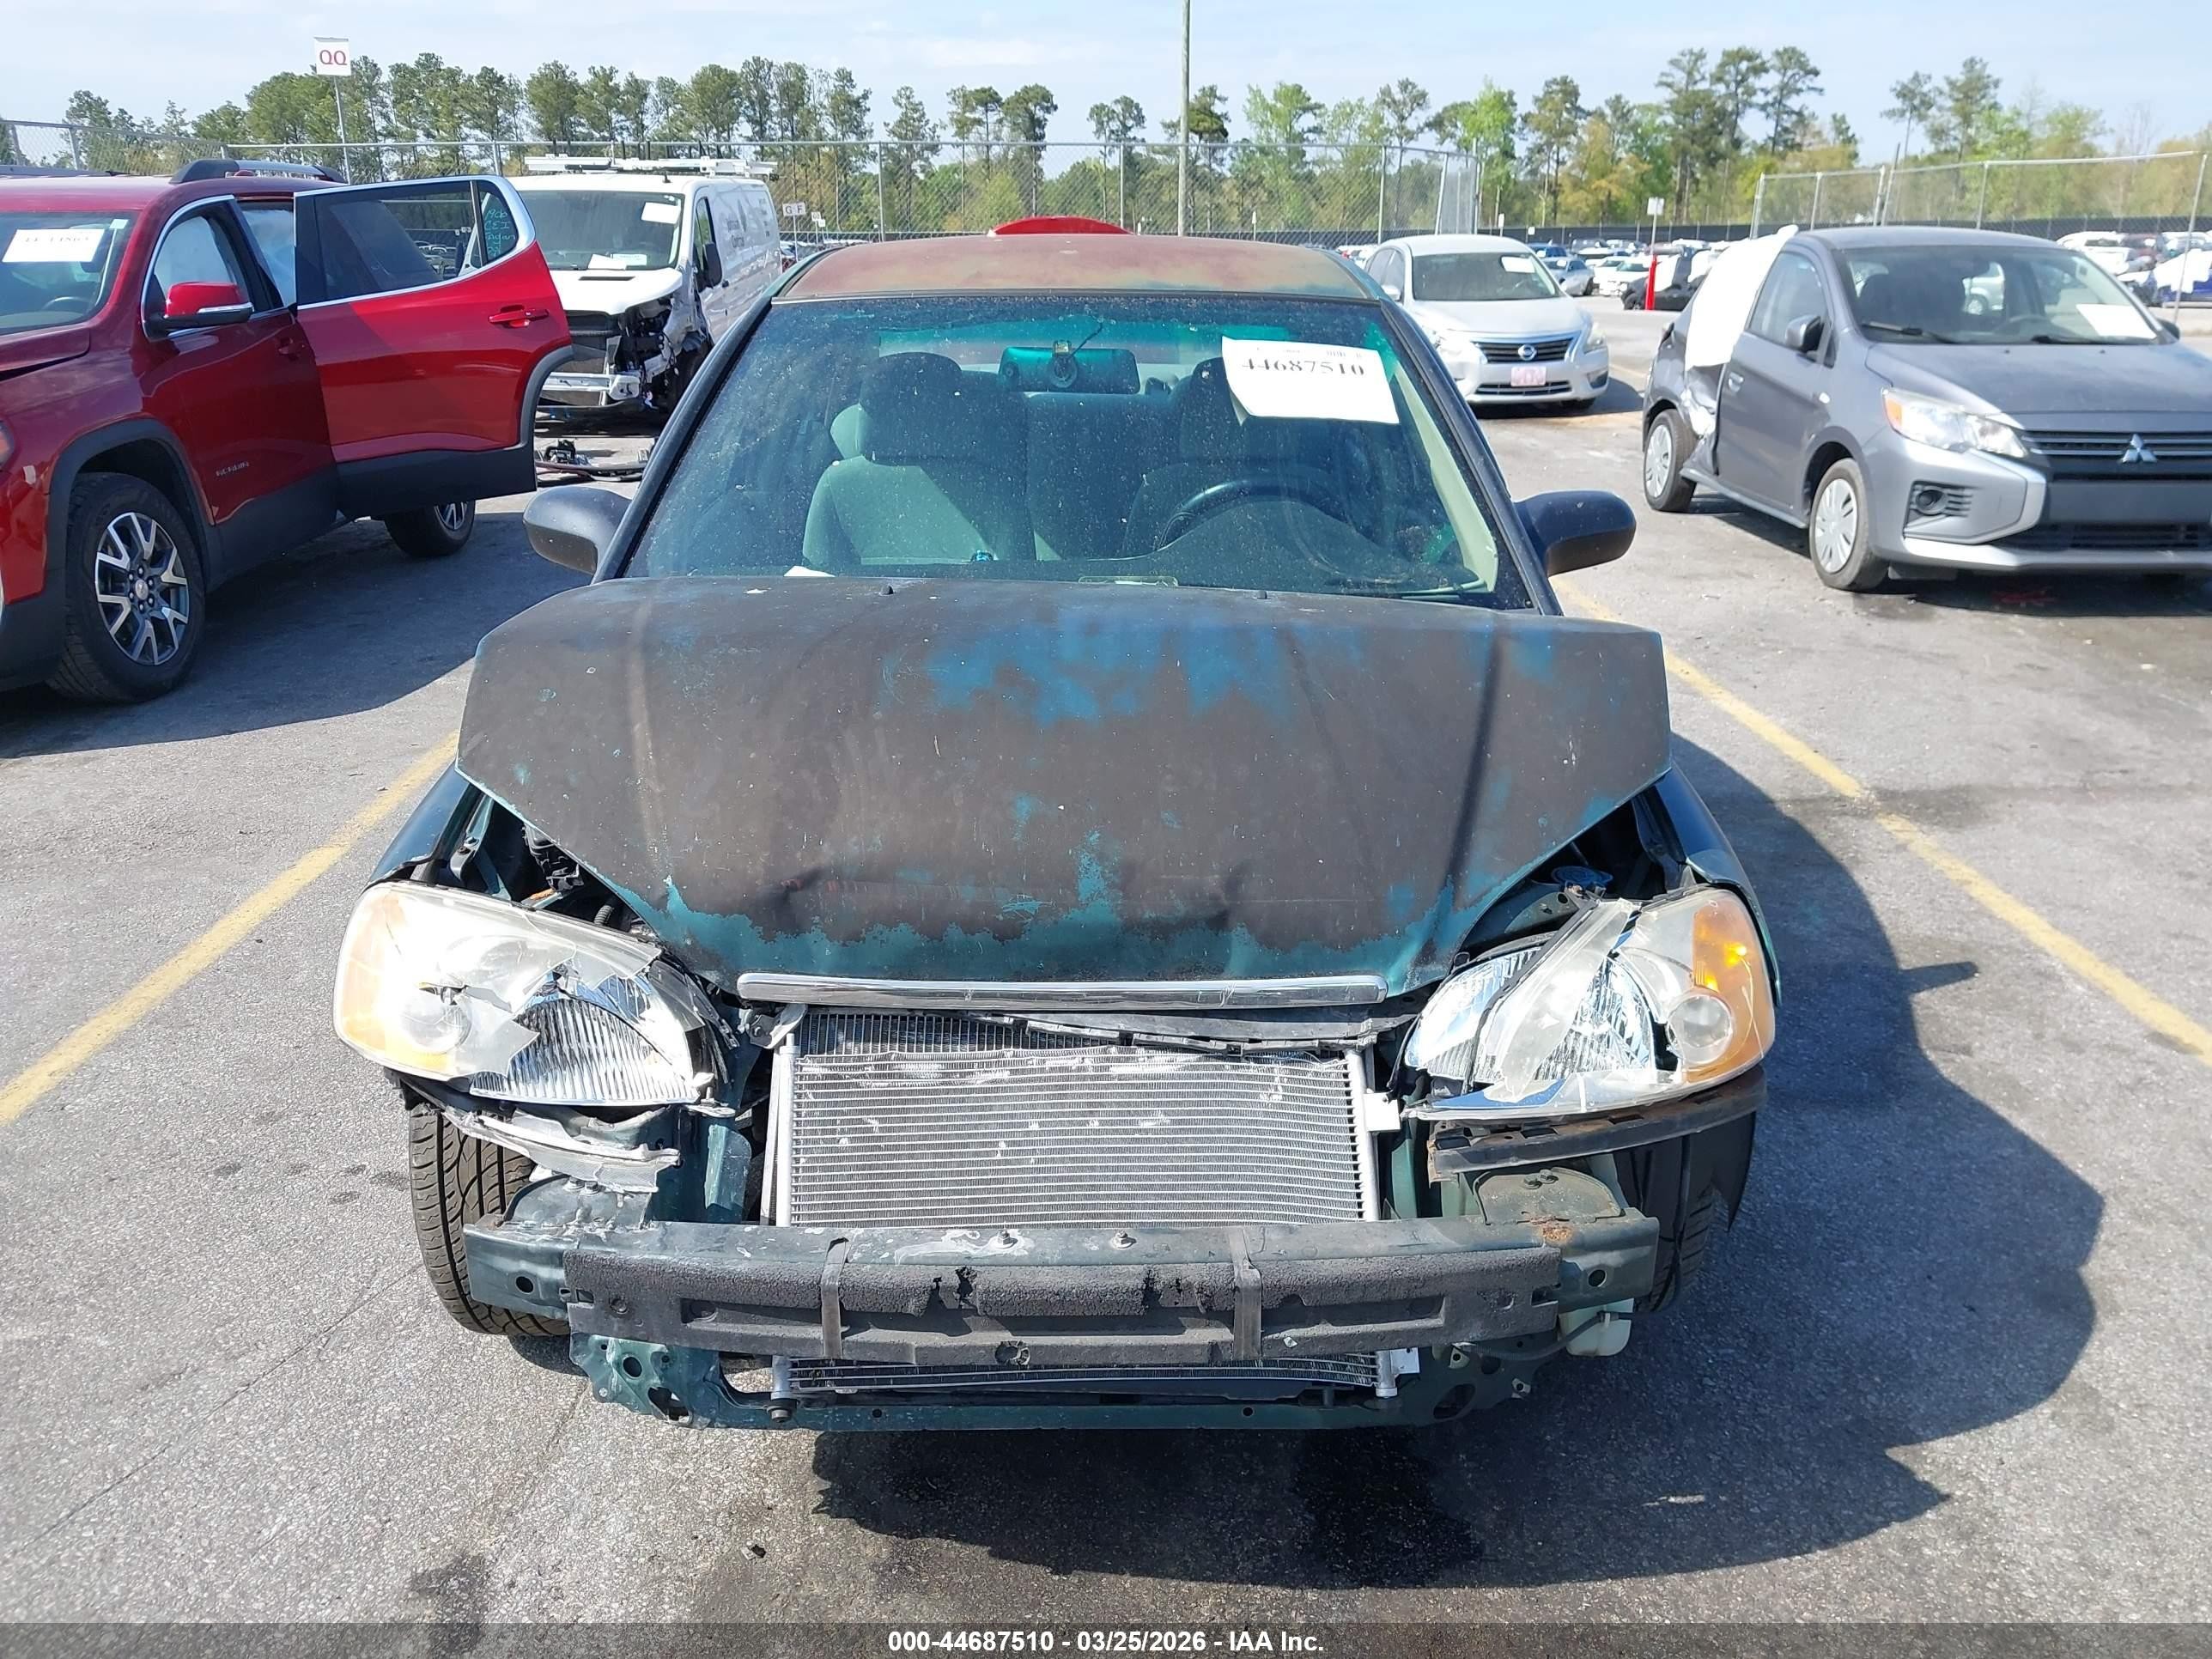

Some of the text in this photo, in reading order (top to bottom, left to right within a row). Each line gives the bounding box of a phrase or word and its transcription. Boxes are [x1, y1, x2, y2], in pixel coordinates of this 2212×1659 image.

[319, 49, 348, 66] QQ
[785, 205, 804, 215] G F
[1242, 358, 1364, 376] 44687510
